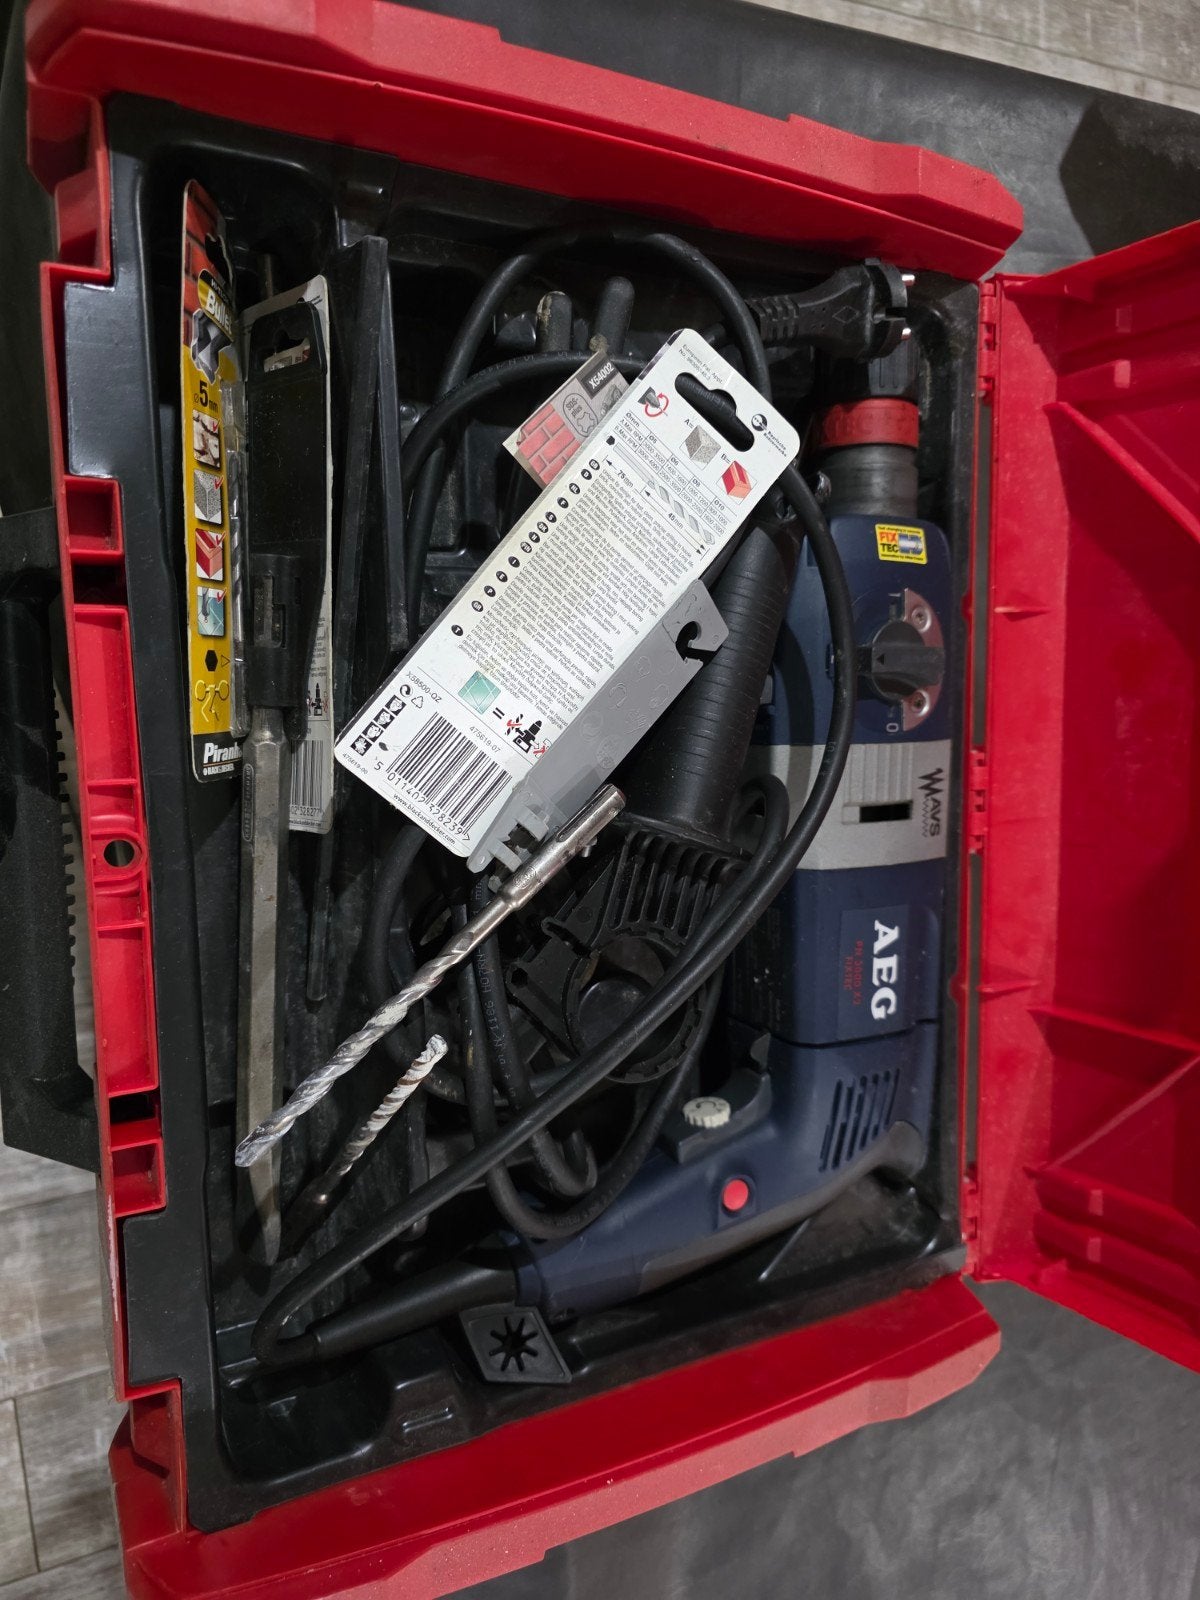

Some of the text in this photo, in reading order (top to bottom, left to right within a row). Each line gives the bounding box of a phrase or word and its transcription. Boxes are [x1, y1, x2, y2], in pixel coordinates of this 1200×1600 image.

[588, 363, 615, 389] X54002
[880, 532, 896, 542] FIX
[881, 543, 899, 554] TEC
[468, 724, 501, 754] 475619-07
[373, 760, 383, 771] 5
[425, 802, 464, 836] 328239
[392, 792, 456, 845] www.blackanddecker.com
[870, 919, 899, 1019] AEG
